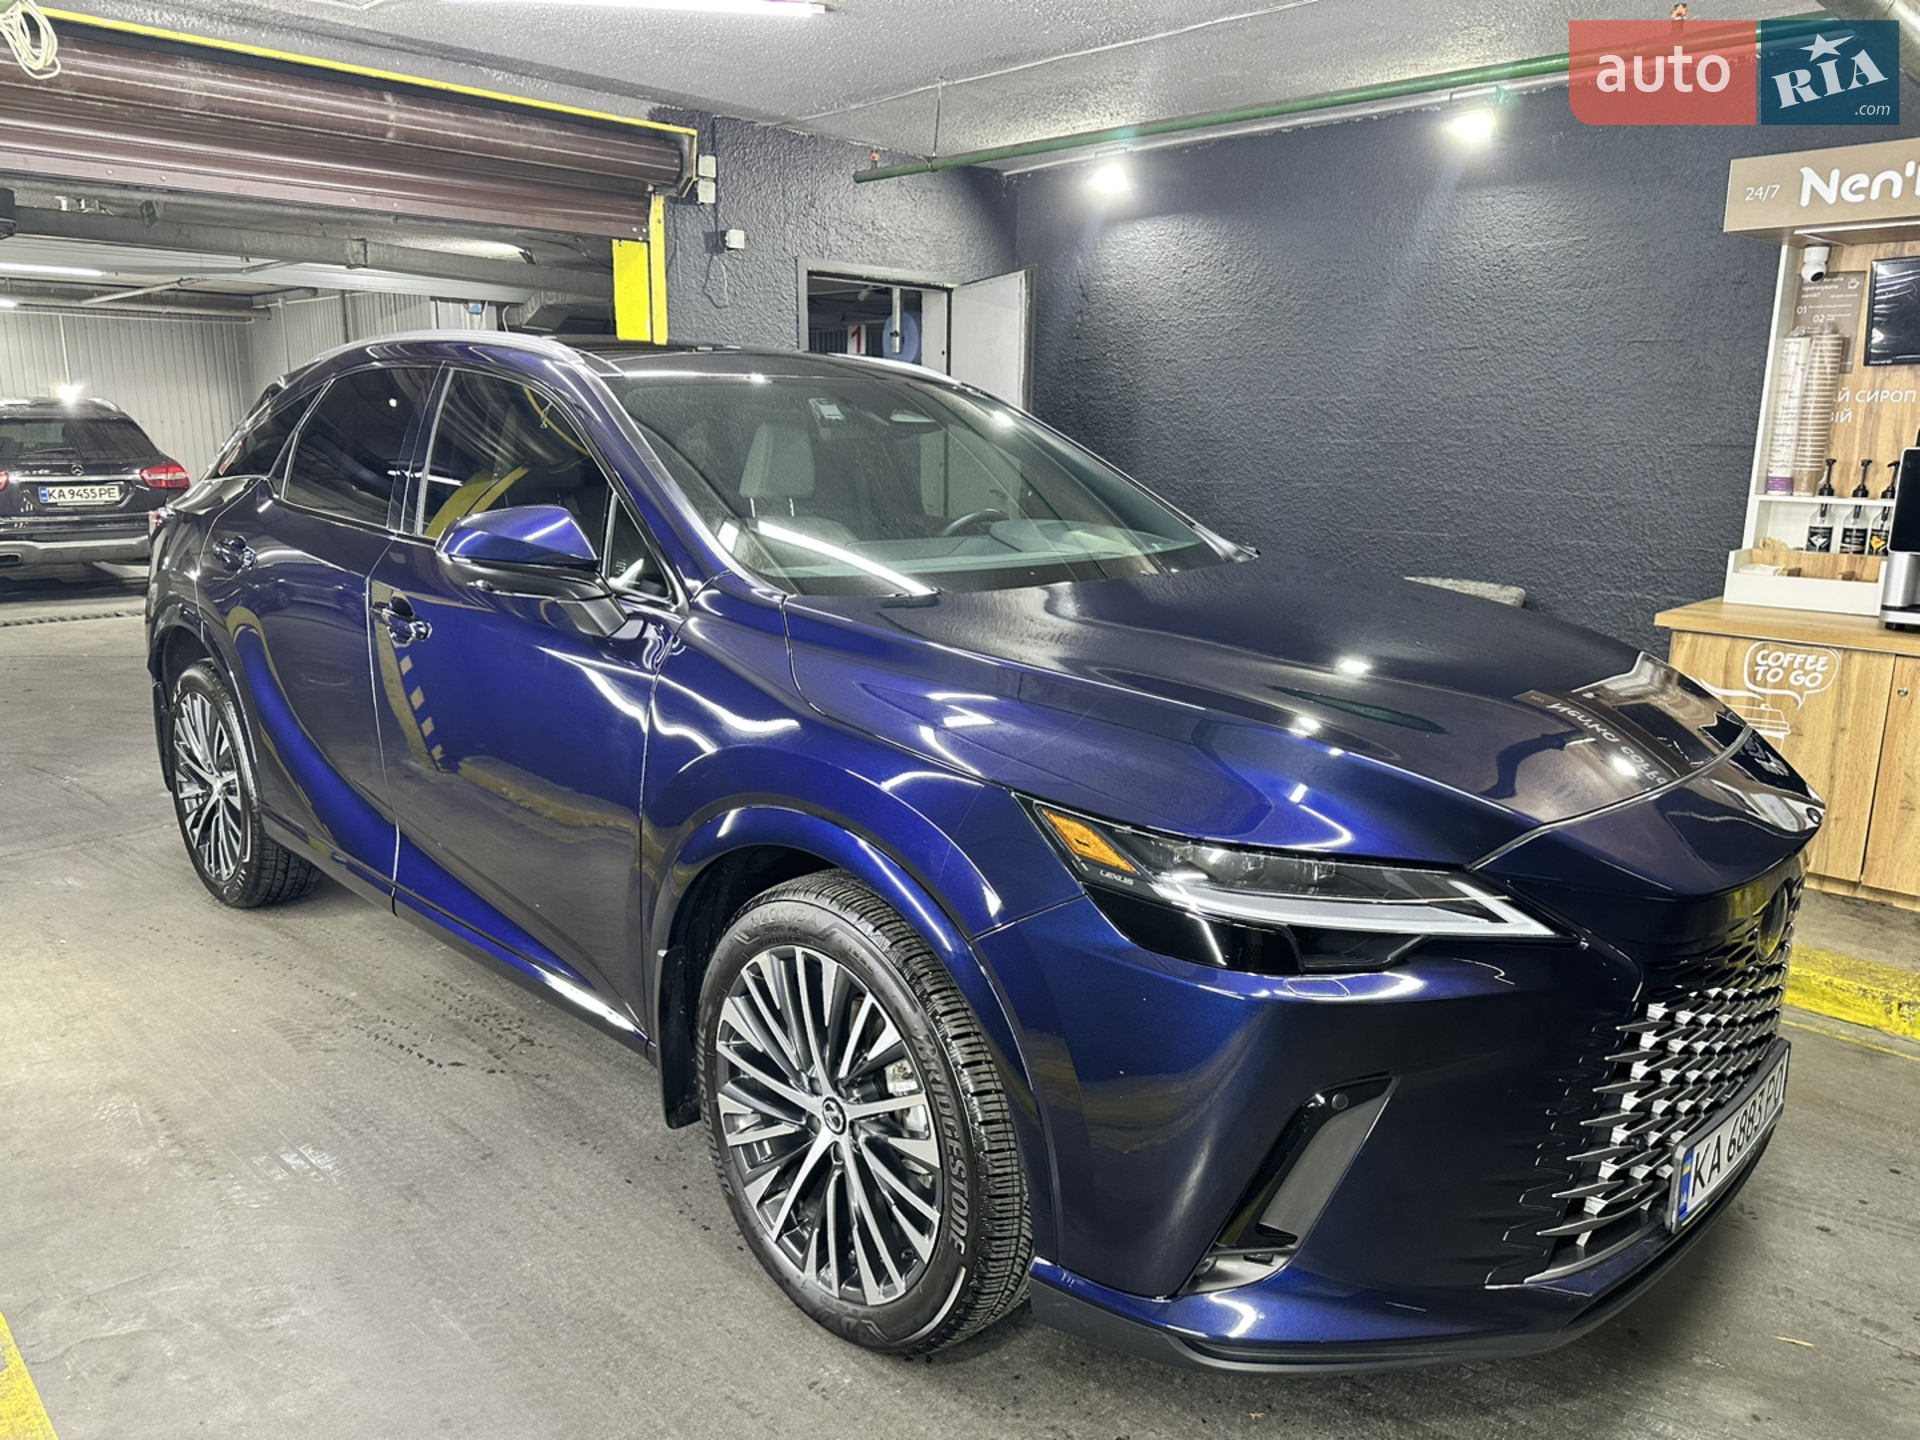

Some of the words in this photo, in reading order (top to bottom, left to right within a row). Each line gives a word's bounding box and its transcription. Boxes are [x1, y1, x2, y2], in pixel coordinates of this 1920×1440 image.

[1745, 184, 1780, 201] 24/7
[1800, 160, 1920, 208] Nen'
[1796, 305, 1808, 315] 01
[1812, 314, 1825, 323] 02
[851, 325, 862, 354] 1
[1855, 389, 1917, 403] СИРОП
[47, 488, 67, 500] KA
[69, 487, 98, 500] 9455
[99, 486, 117, 499] PE
[1756, 649, 1829, 672] COFFEE
[1754, 666, 1784, 683] TO
[1789, 669, 1823, 688] GO
[1099, 868, 1135, 886] LEXUS
[914, 1029, 971, 1257] BRIDGESTONE
[1691, 1134, 1722, 1198] KA
